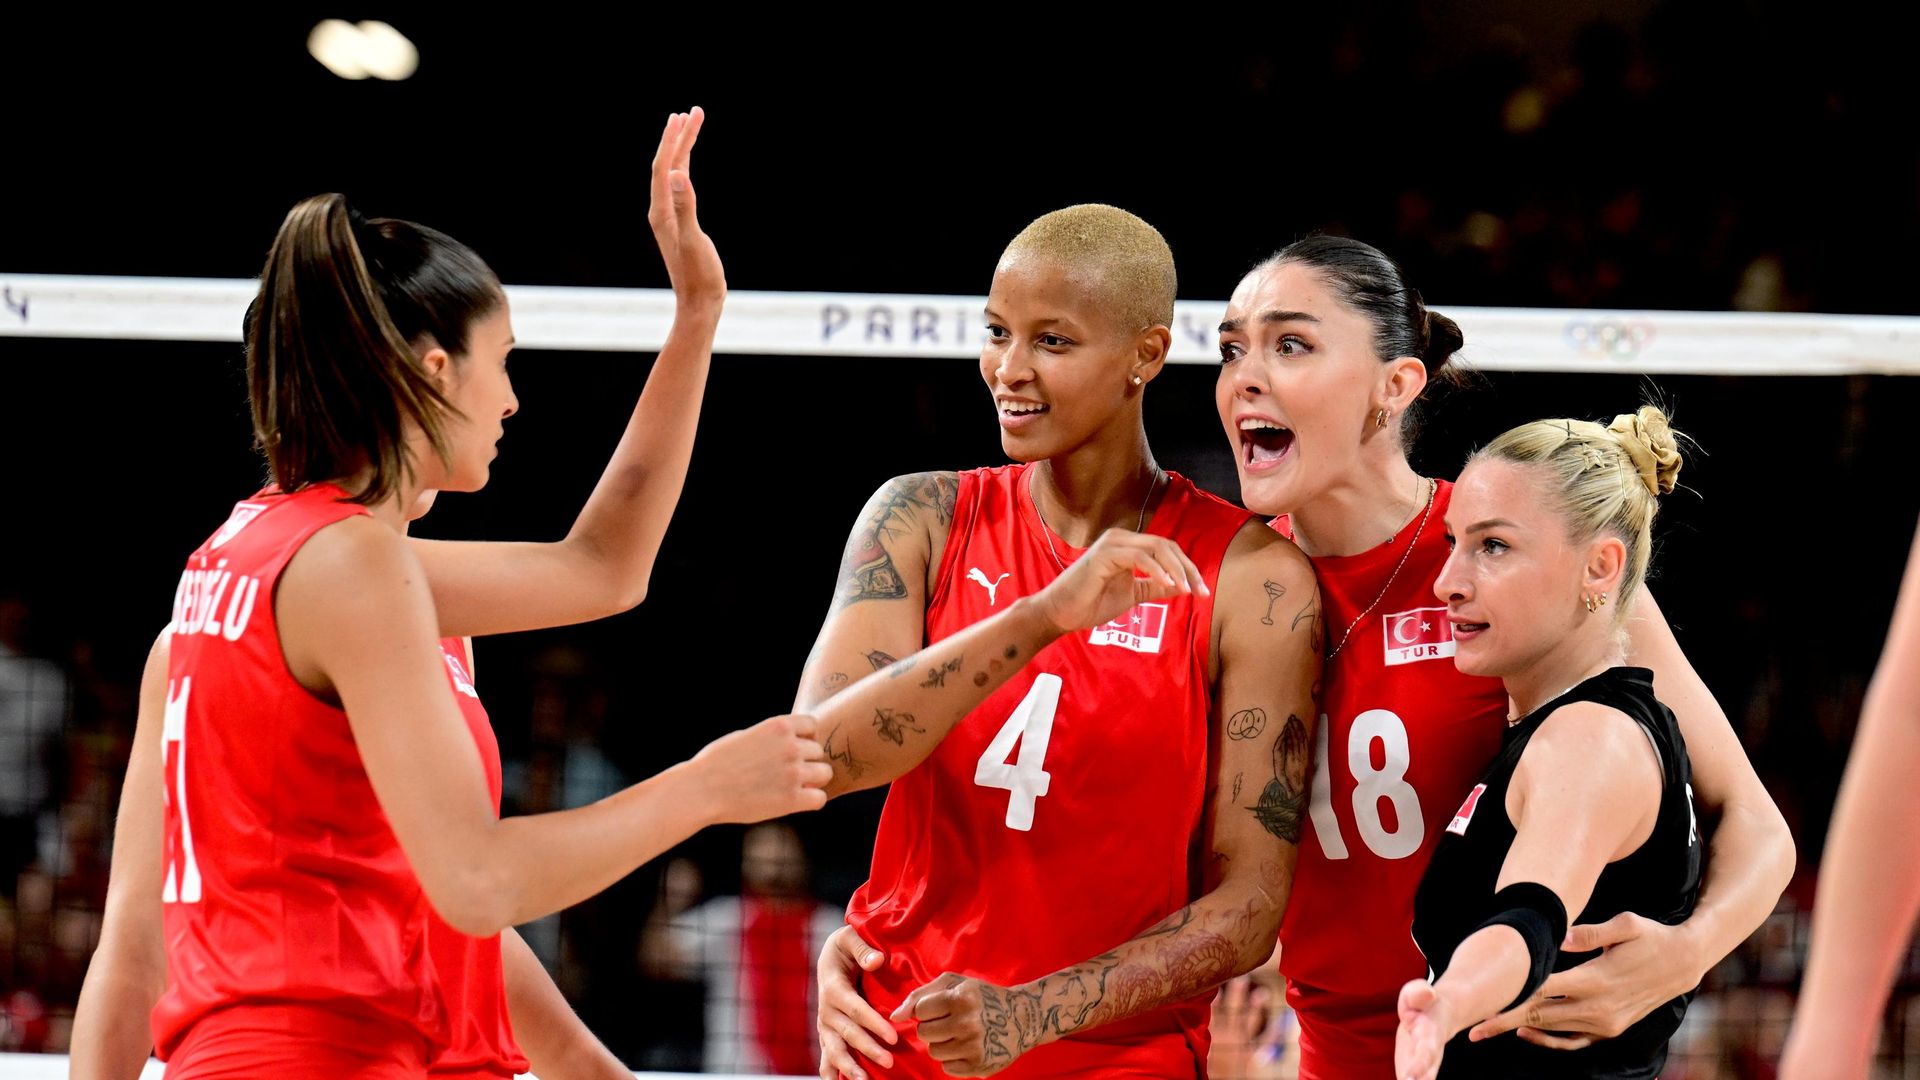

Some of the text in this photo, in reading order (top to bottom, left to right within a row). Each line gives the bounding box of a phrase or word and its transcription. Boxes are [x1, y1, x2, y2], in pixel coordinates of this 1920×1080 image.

[821, 304, 986, 346] PARI
[1106, 631, 1141, 649] TUR
[1400, 645, 1439, 660] TUR
[974, 672, 1063, 832] 4
[1308, 708, 1426, 860] 18
